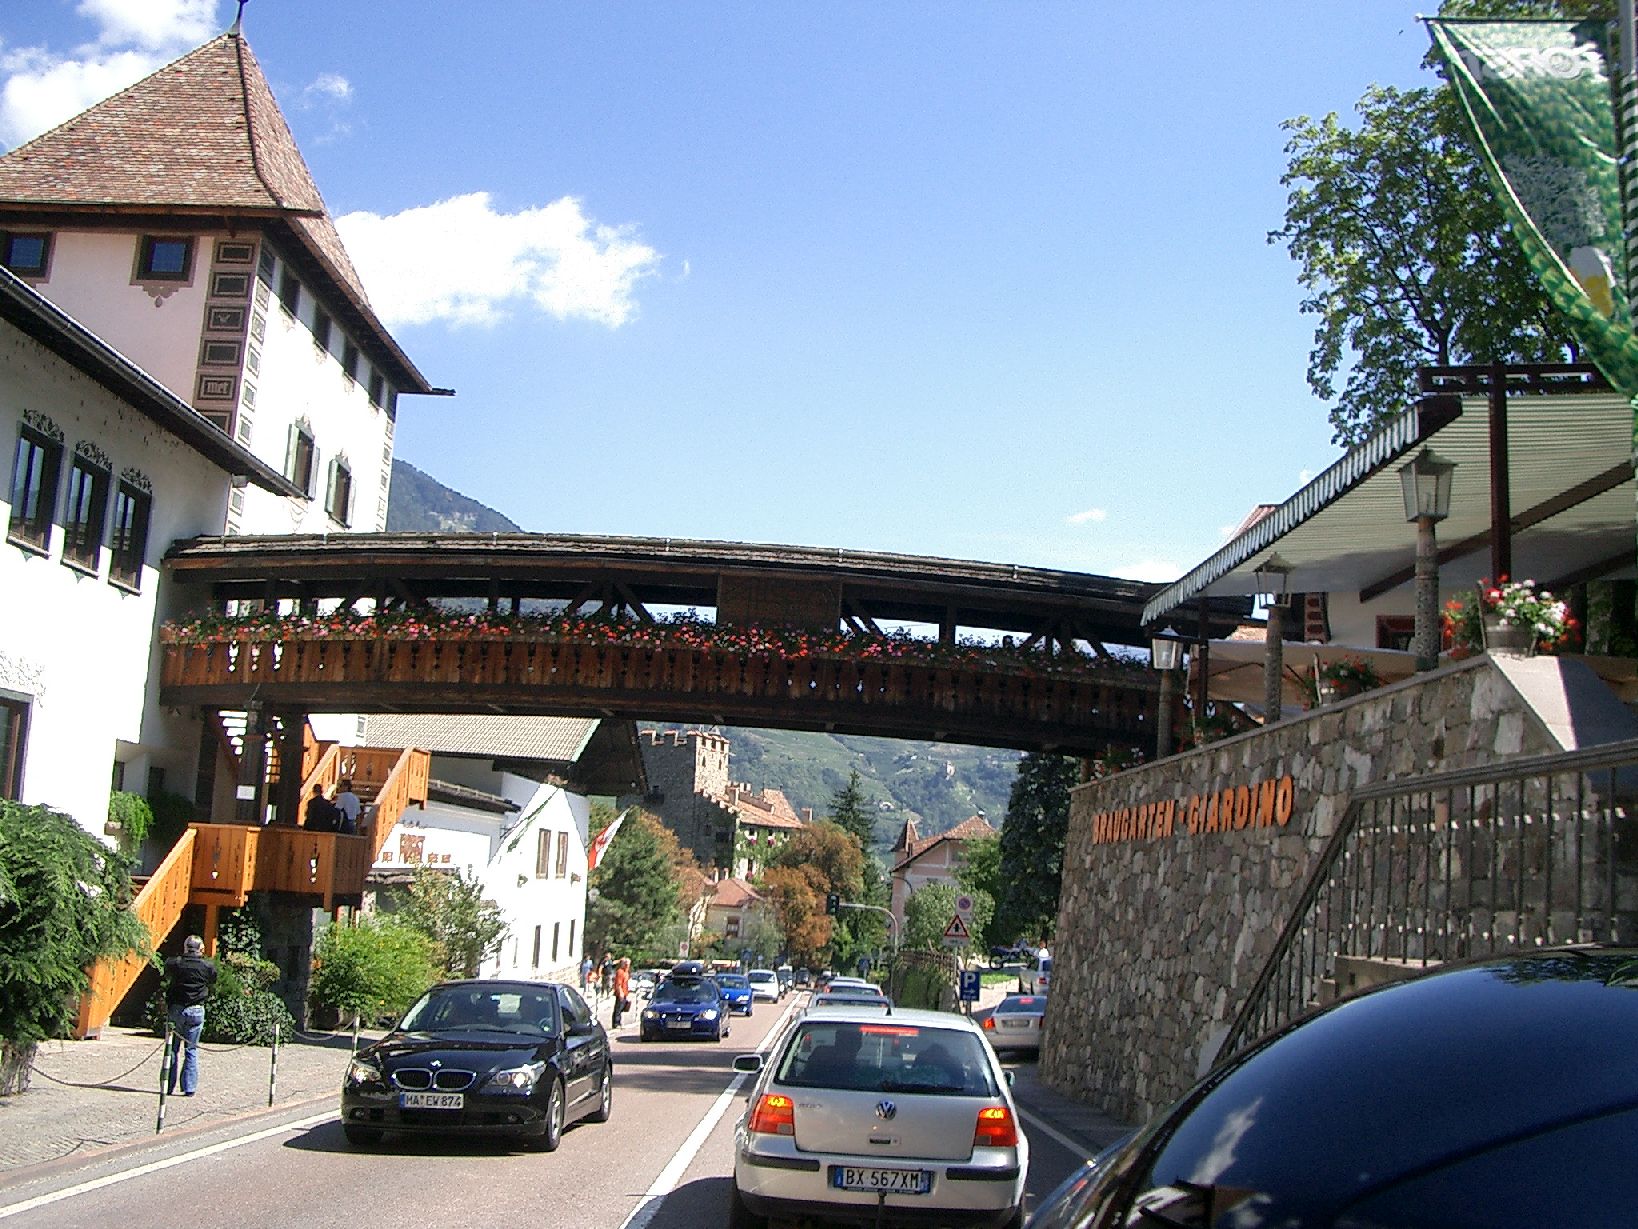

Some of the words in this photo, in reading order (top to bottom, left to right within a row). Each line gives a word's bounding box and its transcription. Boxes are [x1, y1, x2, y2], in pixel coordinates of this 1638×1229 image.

[1092, 799, 1175, 845] BRAUGARTEN
[1187, 775, 1293, 835] GIARDINO
[964, 972, 976, 988] P
[406, 1095, 420, 1105] HA
[441, 1096, 461, 1107] 874
[846, 1169, 864, 1185] BX
[870, 1171, 919, 1189] 567XM
